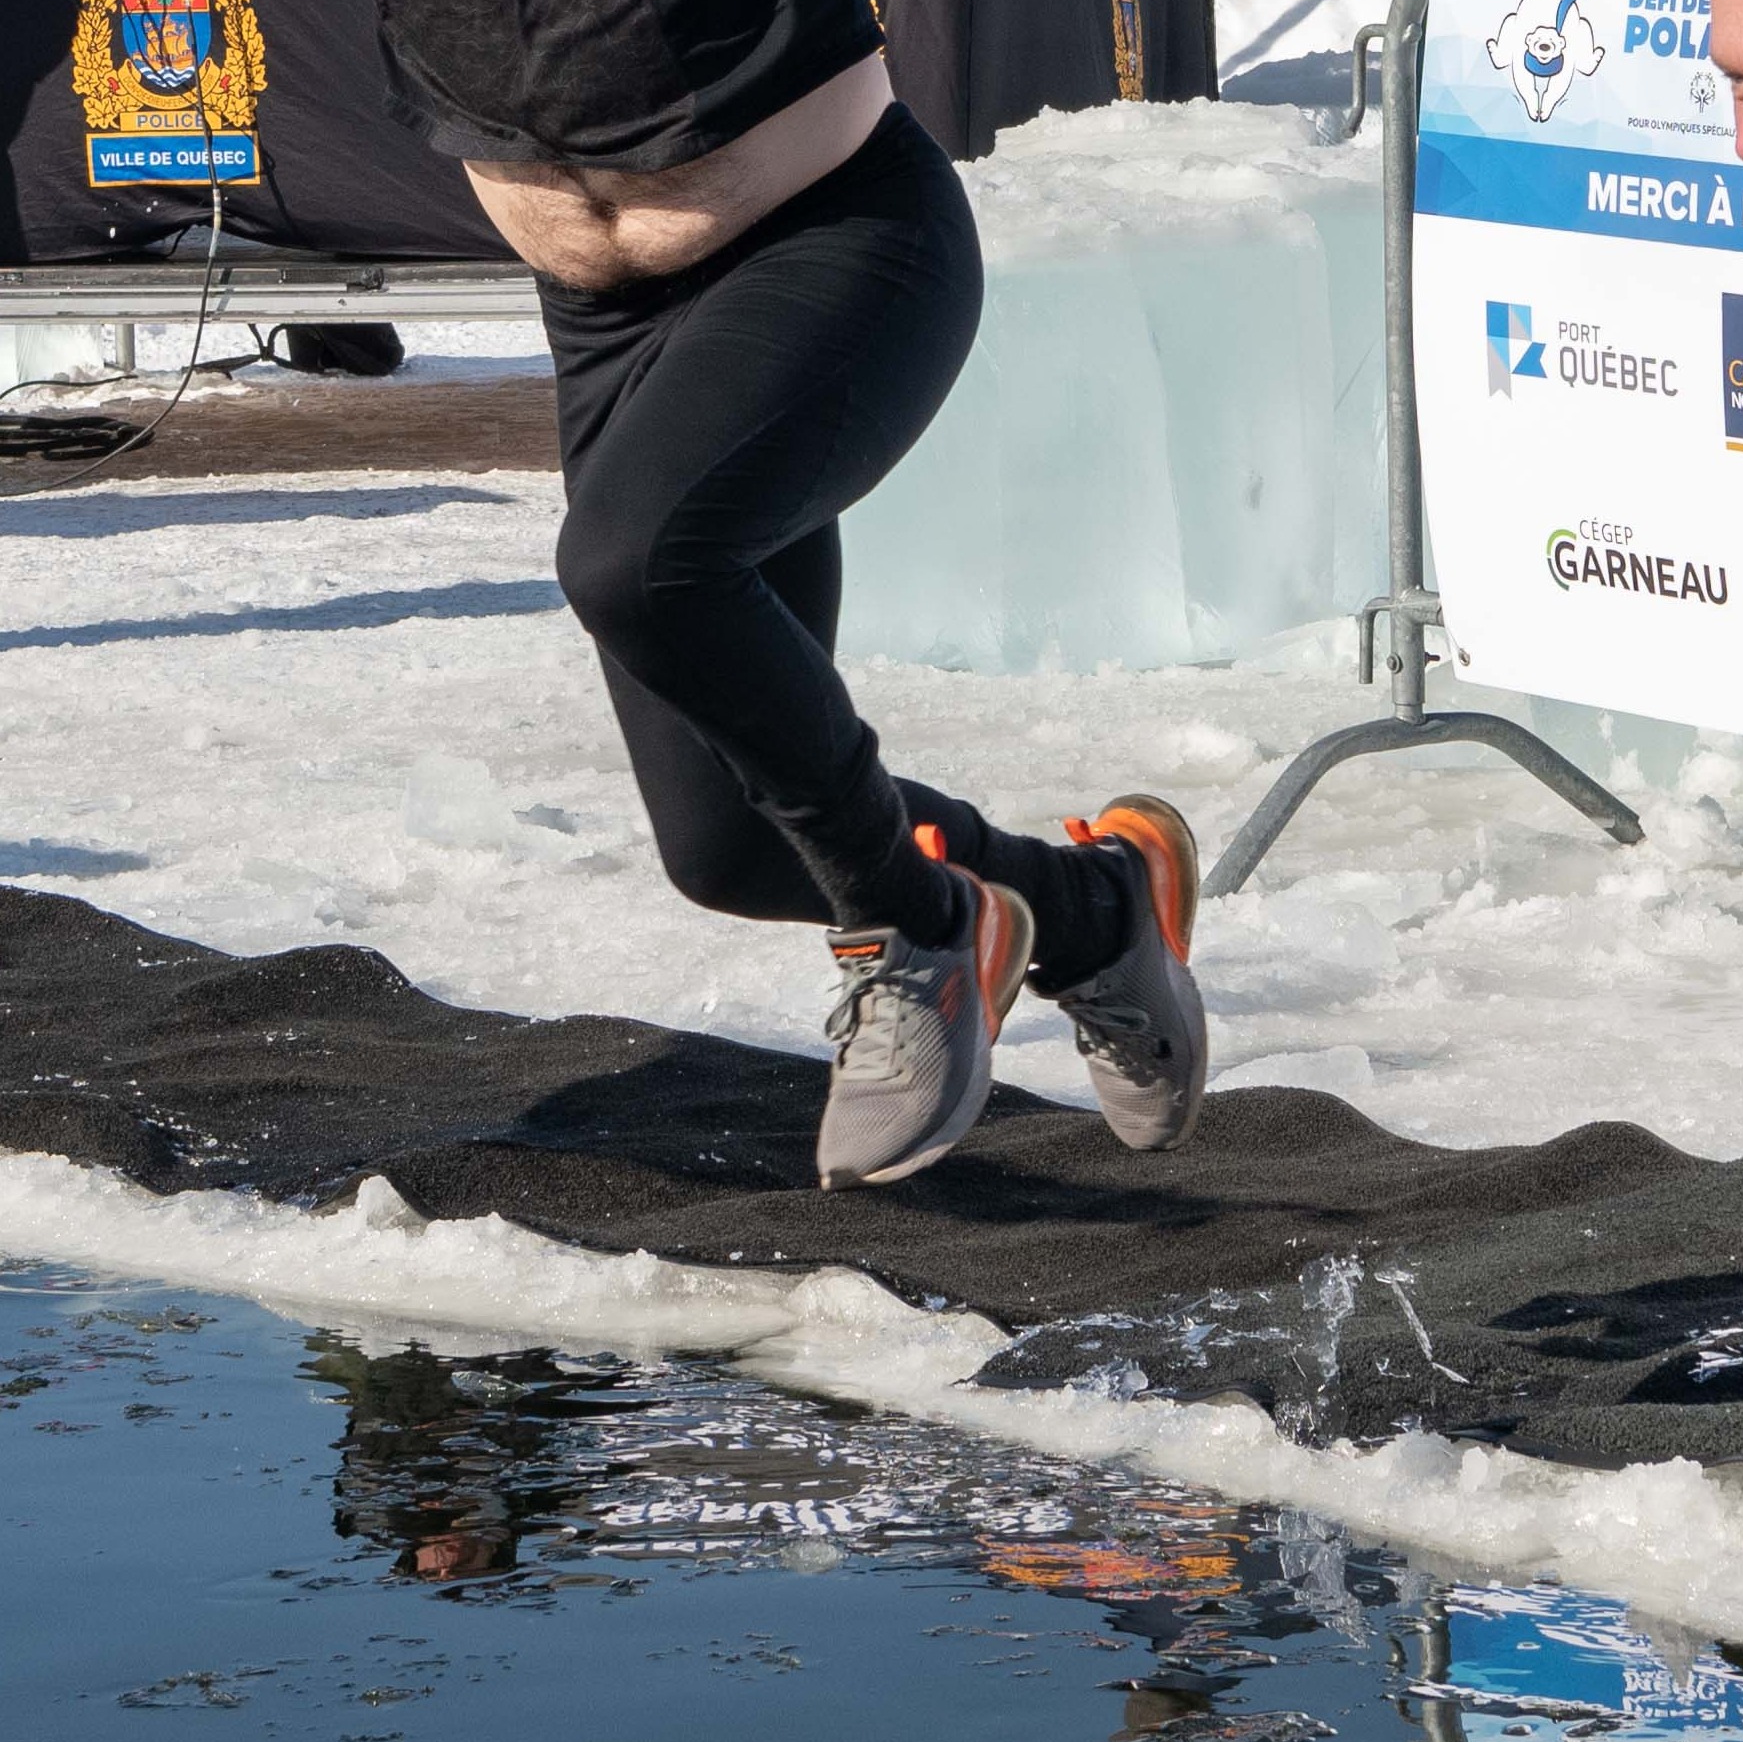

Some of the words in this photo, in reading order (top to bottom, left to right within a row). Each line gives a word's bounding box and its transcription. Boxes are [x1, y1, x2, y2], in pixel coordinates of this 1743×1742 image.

[1622, 13, 1713, 61] POLA
[136, 114, 205, 129] POLICE
[1627, 116, 1649, 130] POUR
[1650, 119, 1701, 136] OLYMPIQUES
[1702, 121, 1736, 139] SPÉCIAU
[100, 152, 146, 167] VILLE
[149, 151, 173, 166] DE
[176, 147, 247, 166] QUÉBEC
[1587, 170, 1698, 222] MERCI
[1706, 175, 1735, 225] À
[1558, 320, 1601, 346] PORT
[1558, 345, 1679, 398] QUÉBEC
[1578, 517, 1634, 546] CÉGEP
[1553, 540, 1729, 606] GARNEAU
